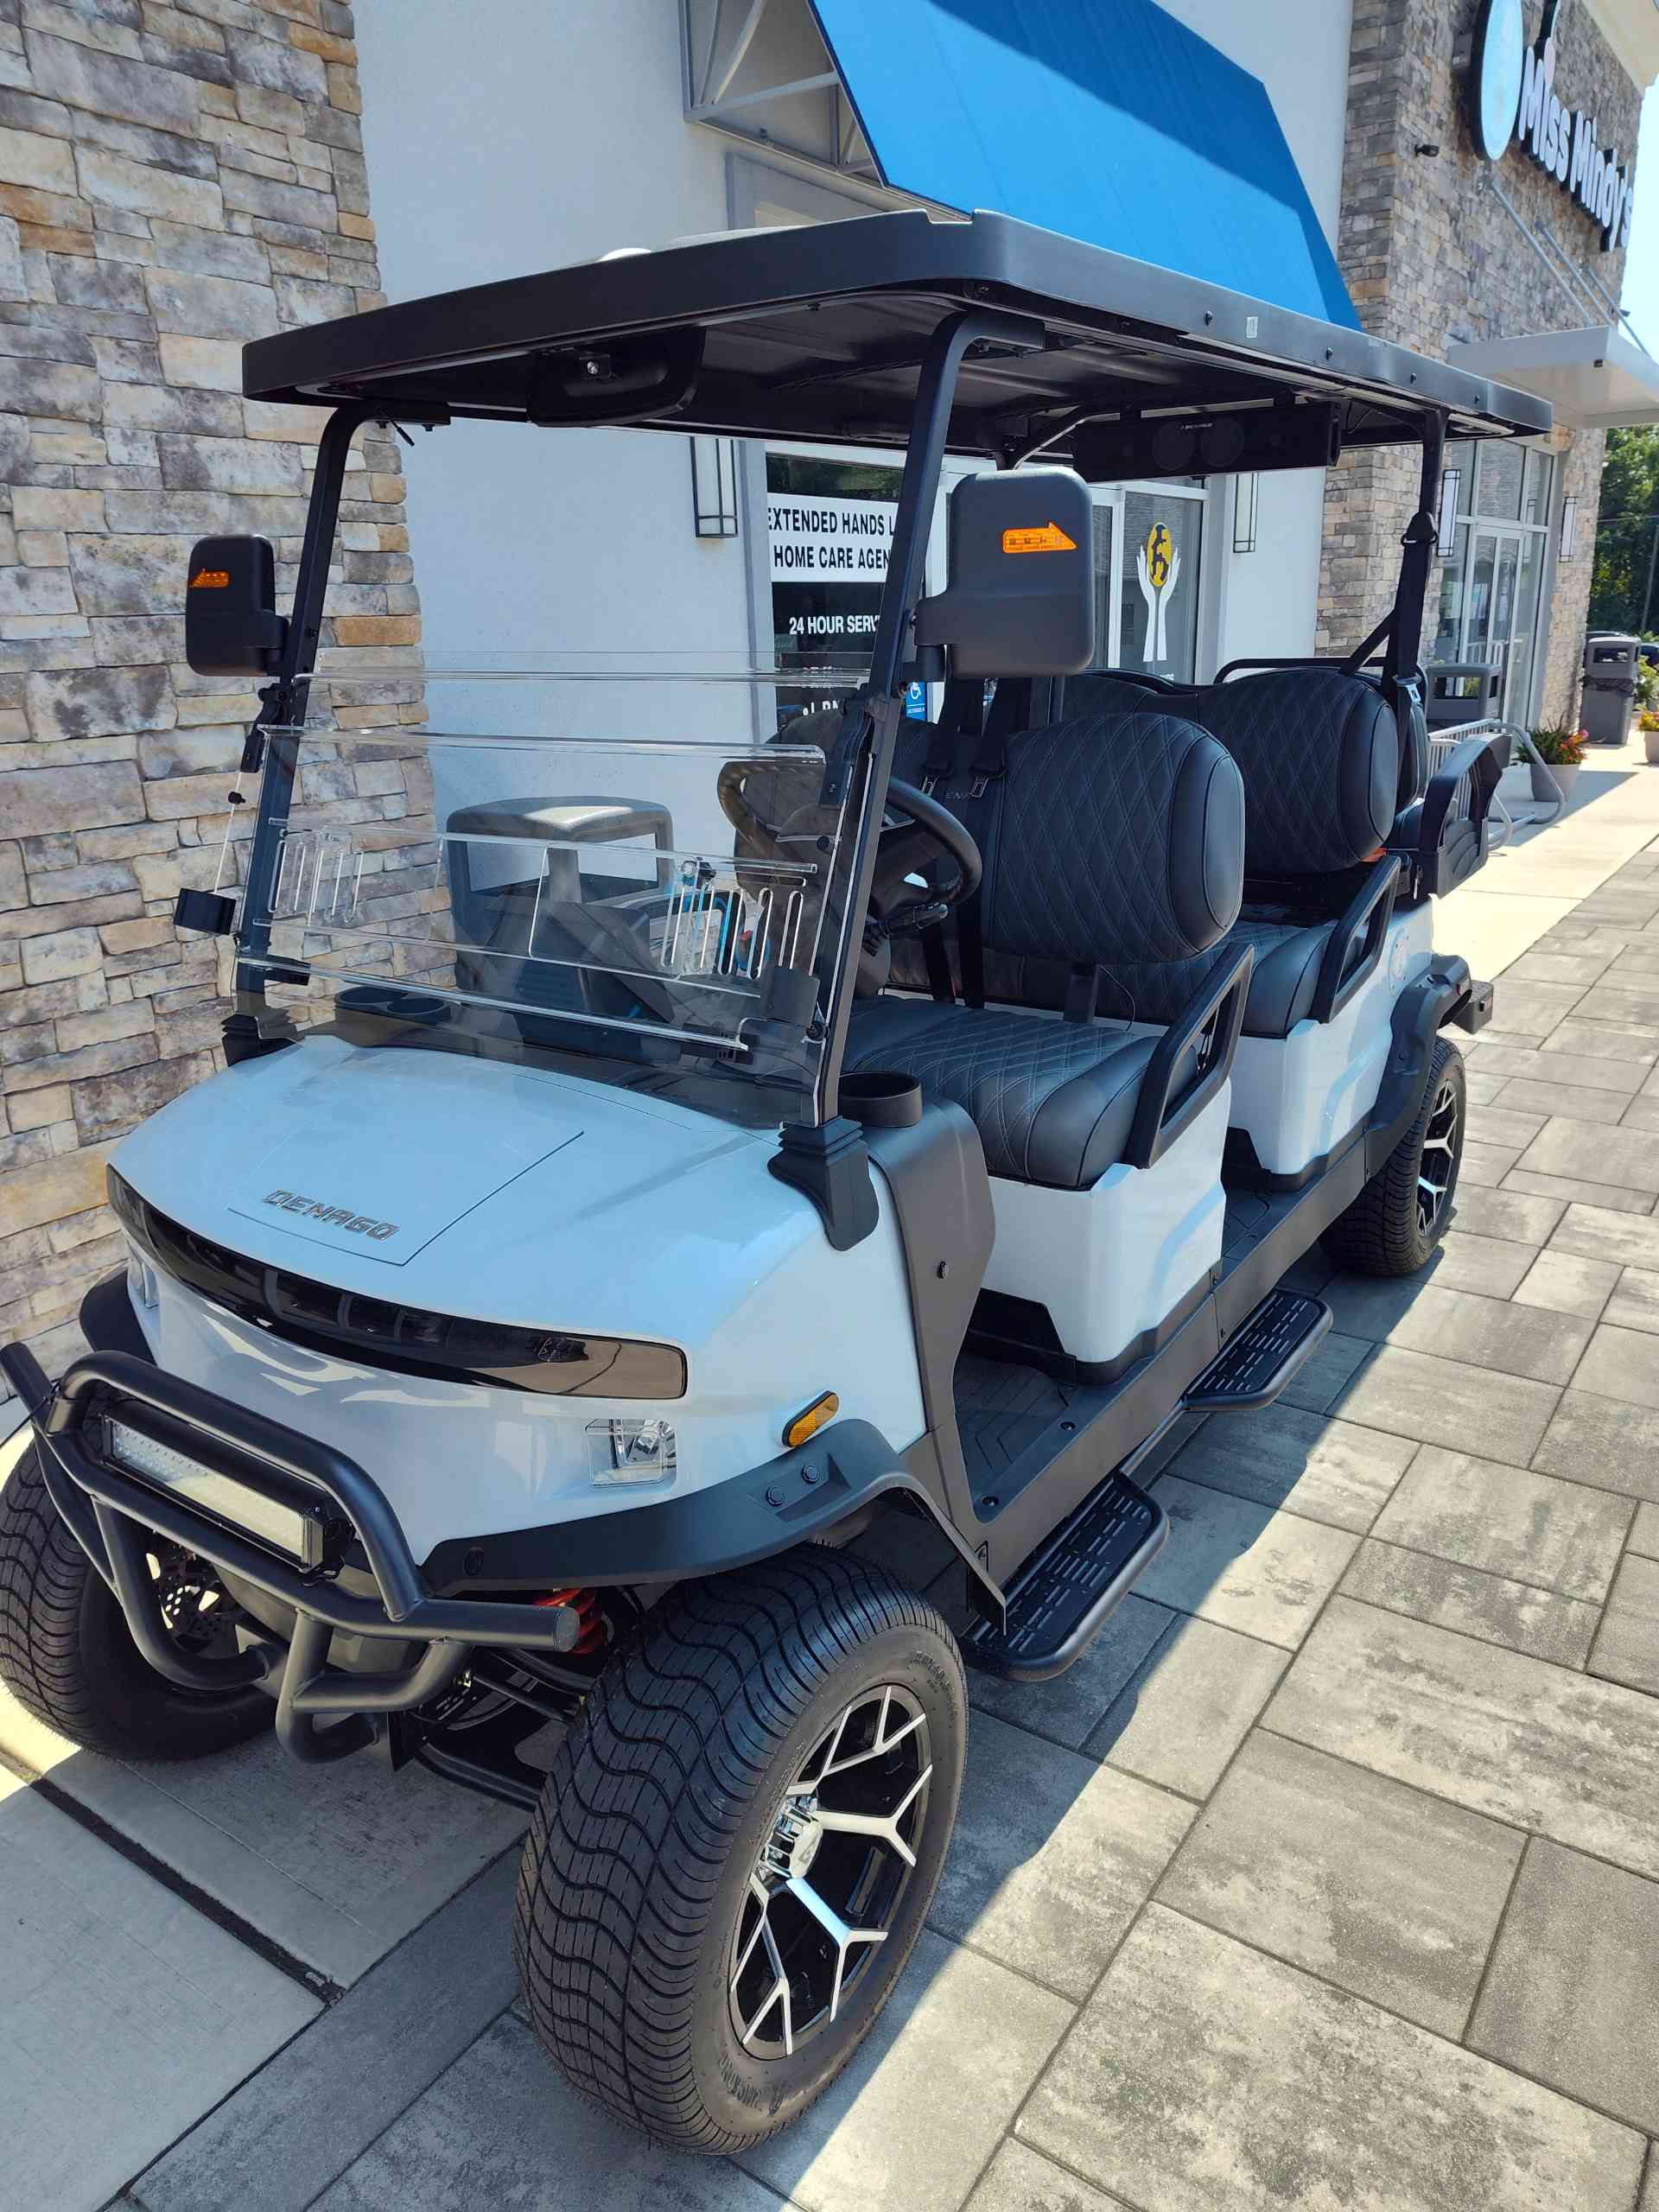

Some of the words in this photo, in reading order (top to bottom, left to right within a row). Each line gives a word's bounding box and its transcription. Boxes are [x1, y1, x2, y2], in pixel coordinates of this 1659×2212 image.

[842, 512, 885, 536] HANDS
[773, 545, 815, 568] HOME
[819, 546, 853, 569] CARE
[789, 616, 804, 635] 24
[807, 615, 844, 634] HOUR
[263, 1188, 400, 1241] DENAGO
